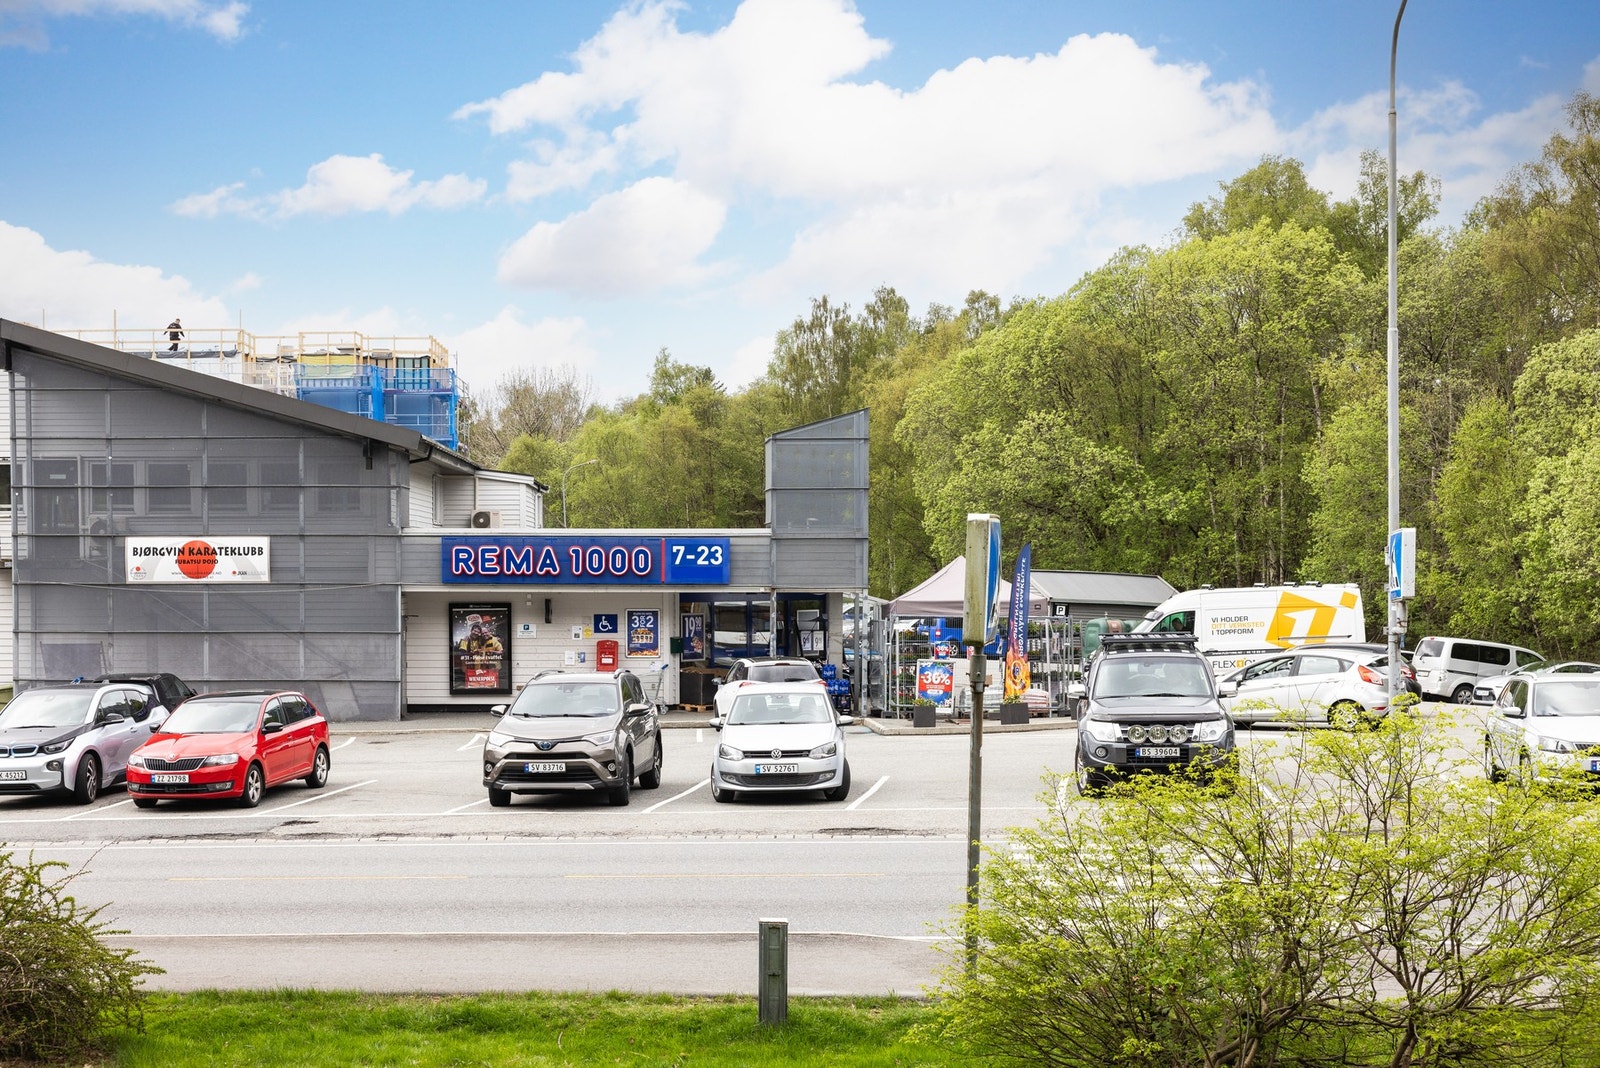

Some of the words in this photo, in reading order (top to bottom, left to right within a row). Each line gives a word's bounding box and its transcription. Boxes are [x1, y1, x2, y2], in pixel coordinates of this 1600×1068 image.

[132, 546, 185, 557] BJØRGVIN
[188, 546, 264, 557] KARATEKLUBB
[672, 545, 723, 565] 7-23
[452, 545, 560, 576] REMA
[569, 545, 651, 576] 1000
[631, 615, 639, 628] 3
[646, 615, 654, 628] 2
